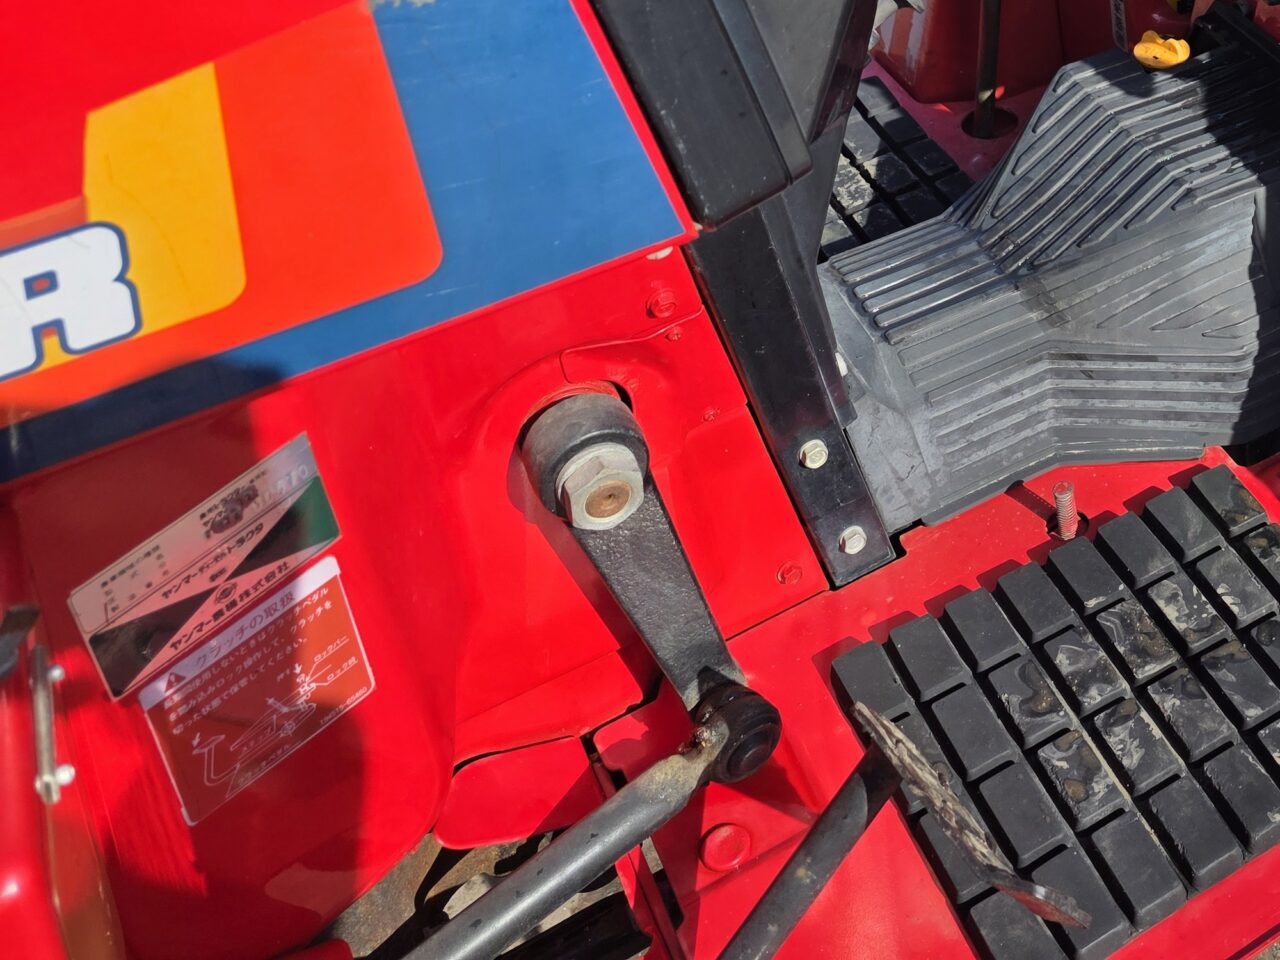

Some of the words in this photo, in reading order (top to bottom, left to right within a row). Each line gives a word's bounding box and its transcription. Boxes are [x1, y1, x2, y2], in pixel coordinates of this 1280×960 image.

[0, 221, 142, 382] R
[168, 558, 291, 654] ヤンマー農機株式会社
[193, 588, 296, 669] クラッチの取扱
